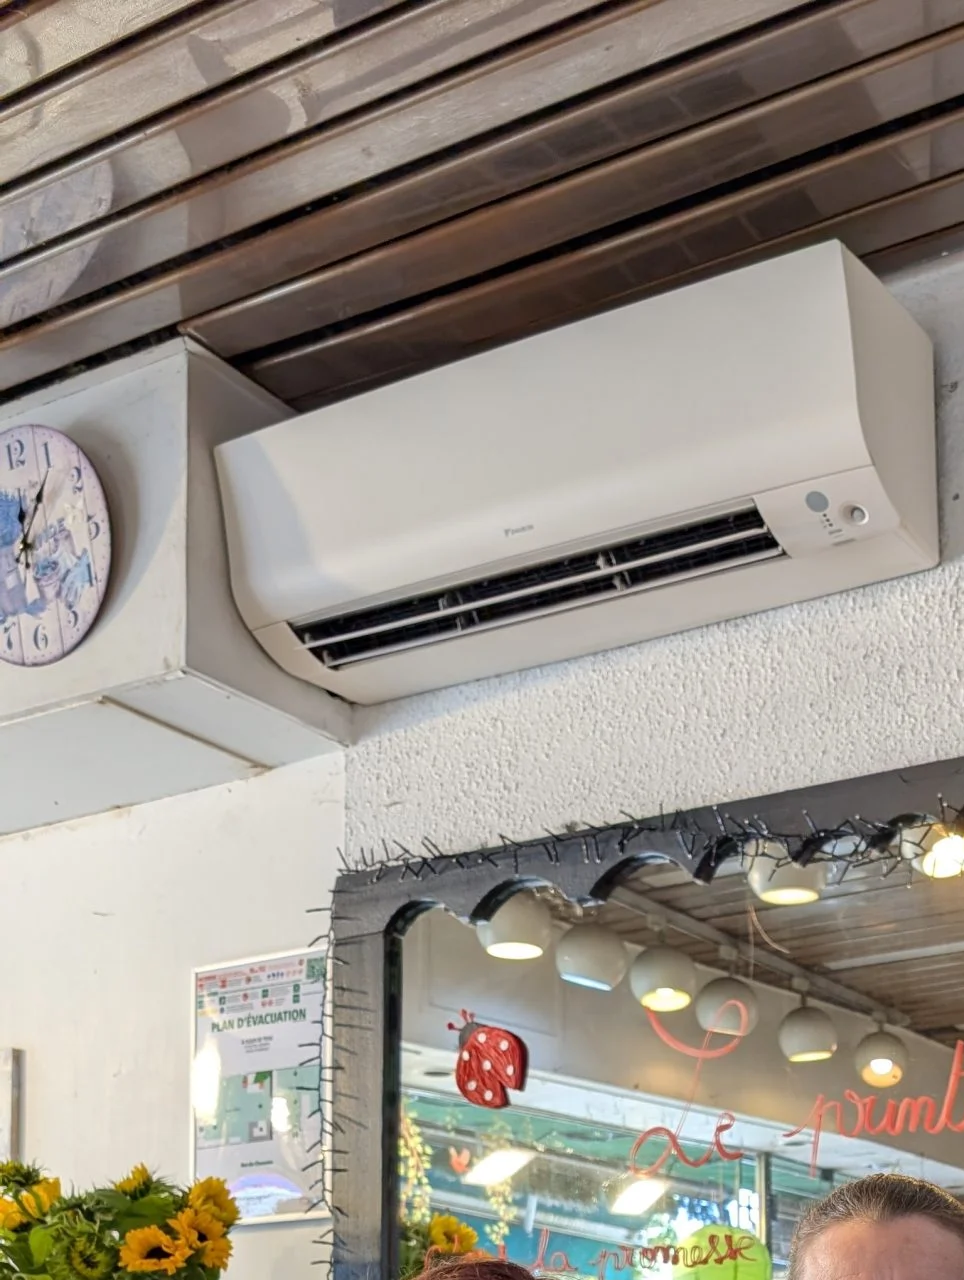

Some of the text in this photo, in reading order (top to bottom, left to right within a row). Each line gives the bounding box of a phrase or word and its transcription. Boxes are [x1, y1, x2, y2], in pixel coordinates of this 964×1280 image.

[6, 439, 26, 471] 12
[42, 441, 53, 470] 1
[69, 466, 83, 495] 2
[33, 623, 49, 651] 6
[211, 1019, 235, 1033] PLAN
[237, 1008, 307, 1029] D'ÉVACUATION
[629, 999, 749, 1177] Le
[528, 1228, 578, 1272] la
